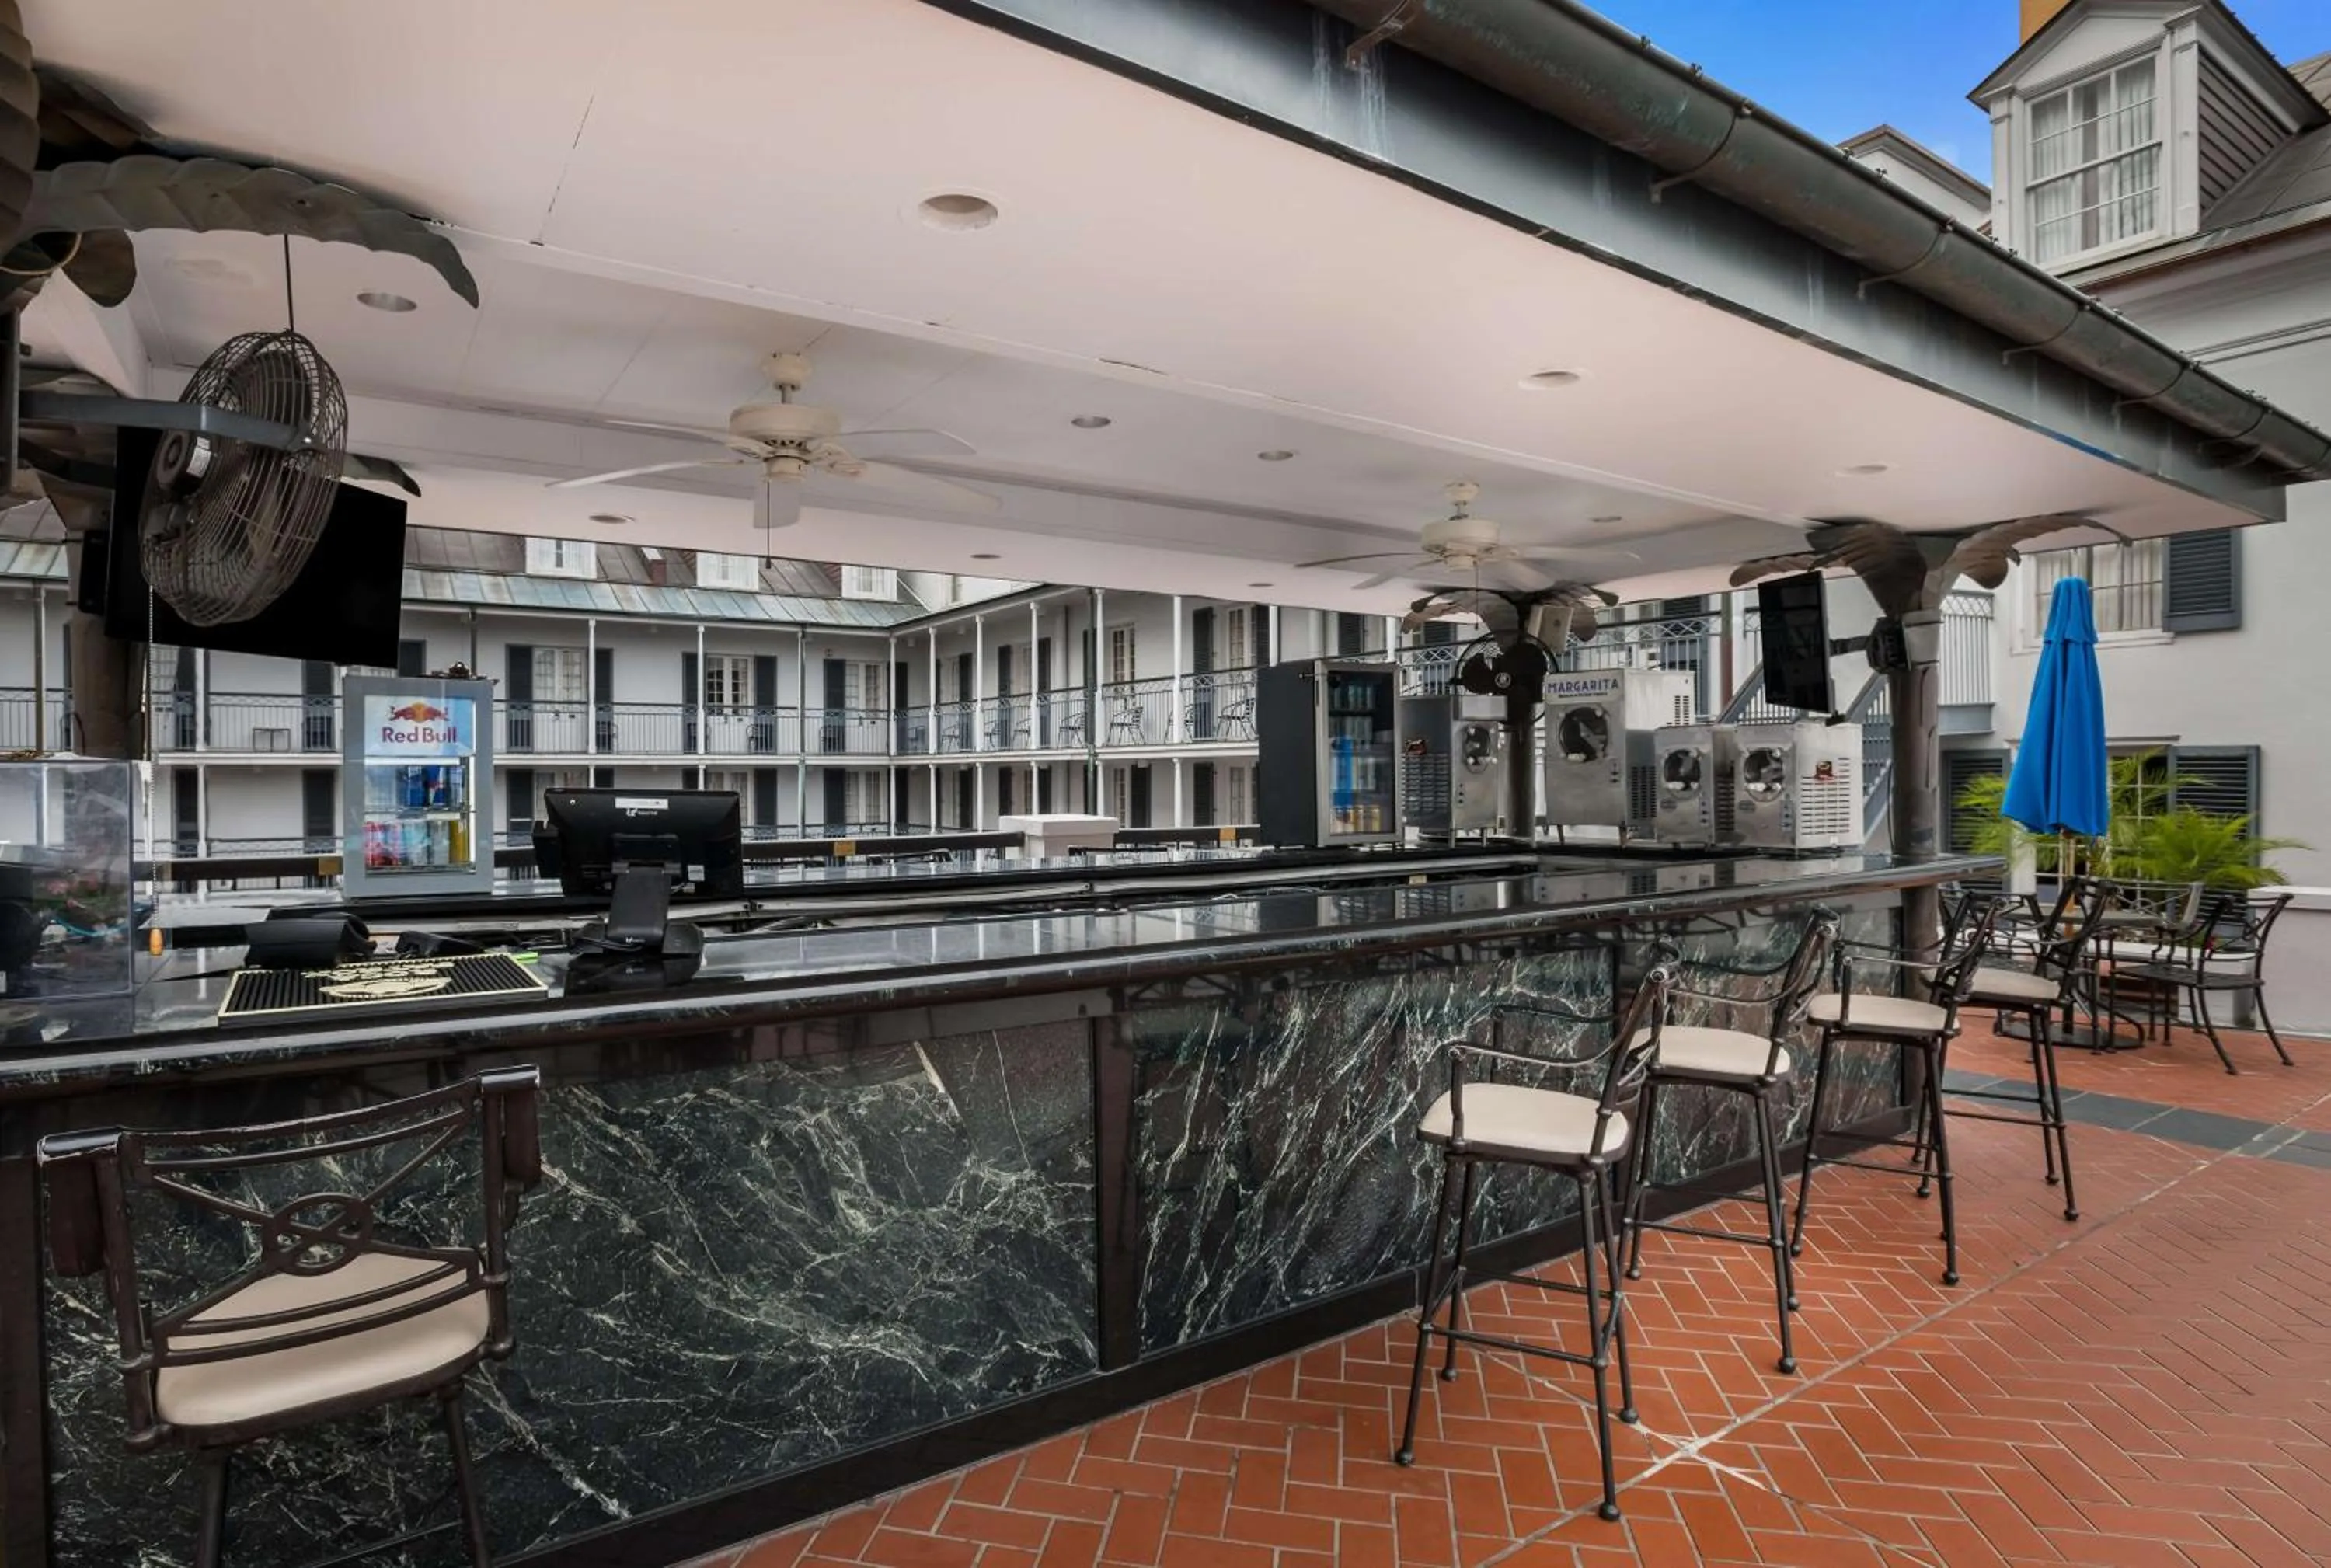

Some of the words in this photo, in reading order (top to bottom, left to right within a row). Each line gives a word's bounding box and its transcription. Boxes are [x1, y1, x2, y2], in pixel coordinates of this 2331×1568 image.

[1548, 678, 1619, 693] MARGARITA
[382, 726, 419, 743] Red
[422, 727, 457, 743] Bull
